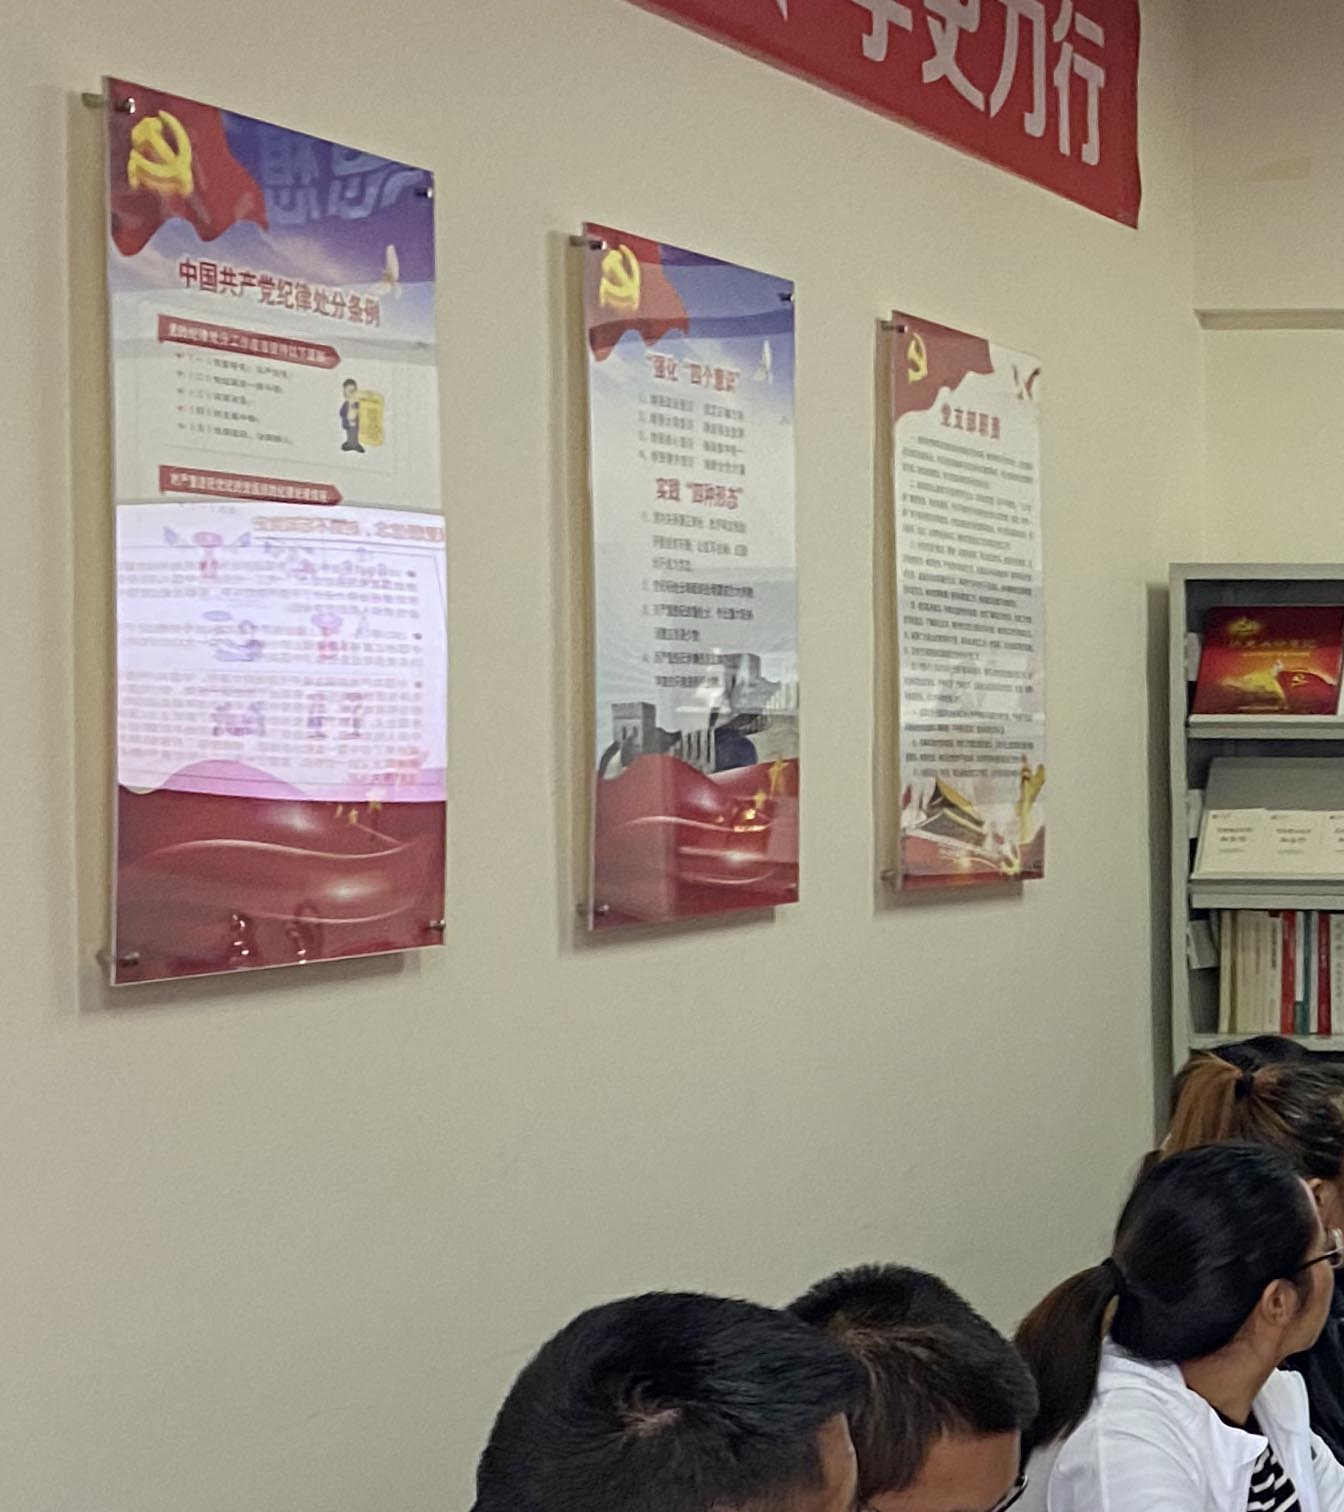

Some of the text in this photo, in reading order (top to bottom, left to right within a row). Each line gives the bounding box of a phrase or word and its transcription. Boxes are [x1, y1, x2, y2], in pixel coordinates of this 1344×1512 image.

[178, 258, 381, 328] 中国共产党纪律处分条例
